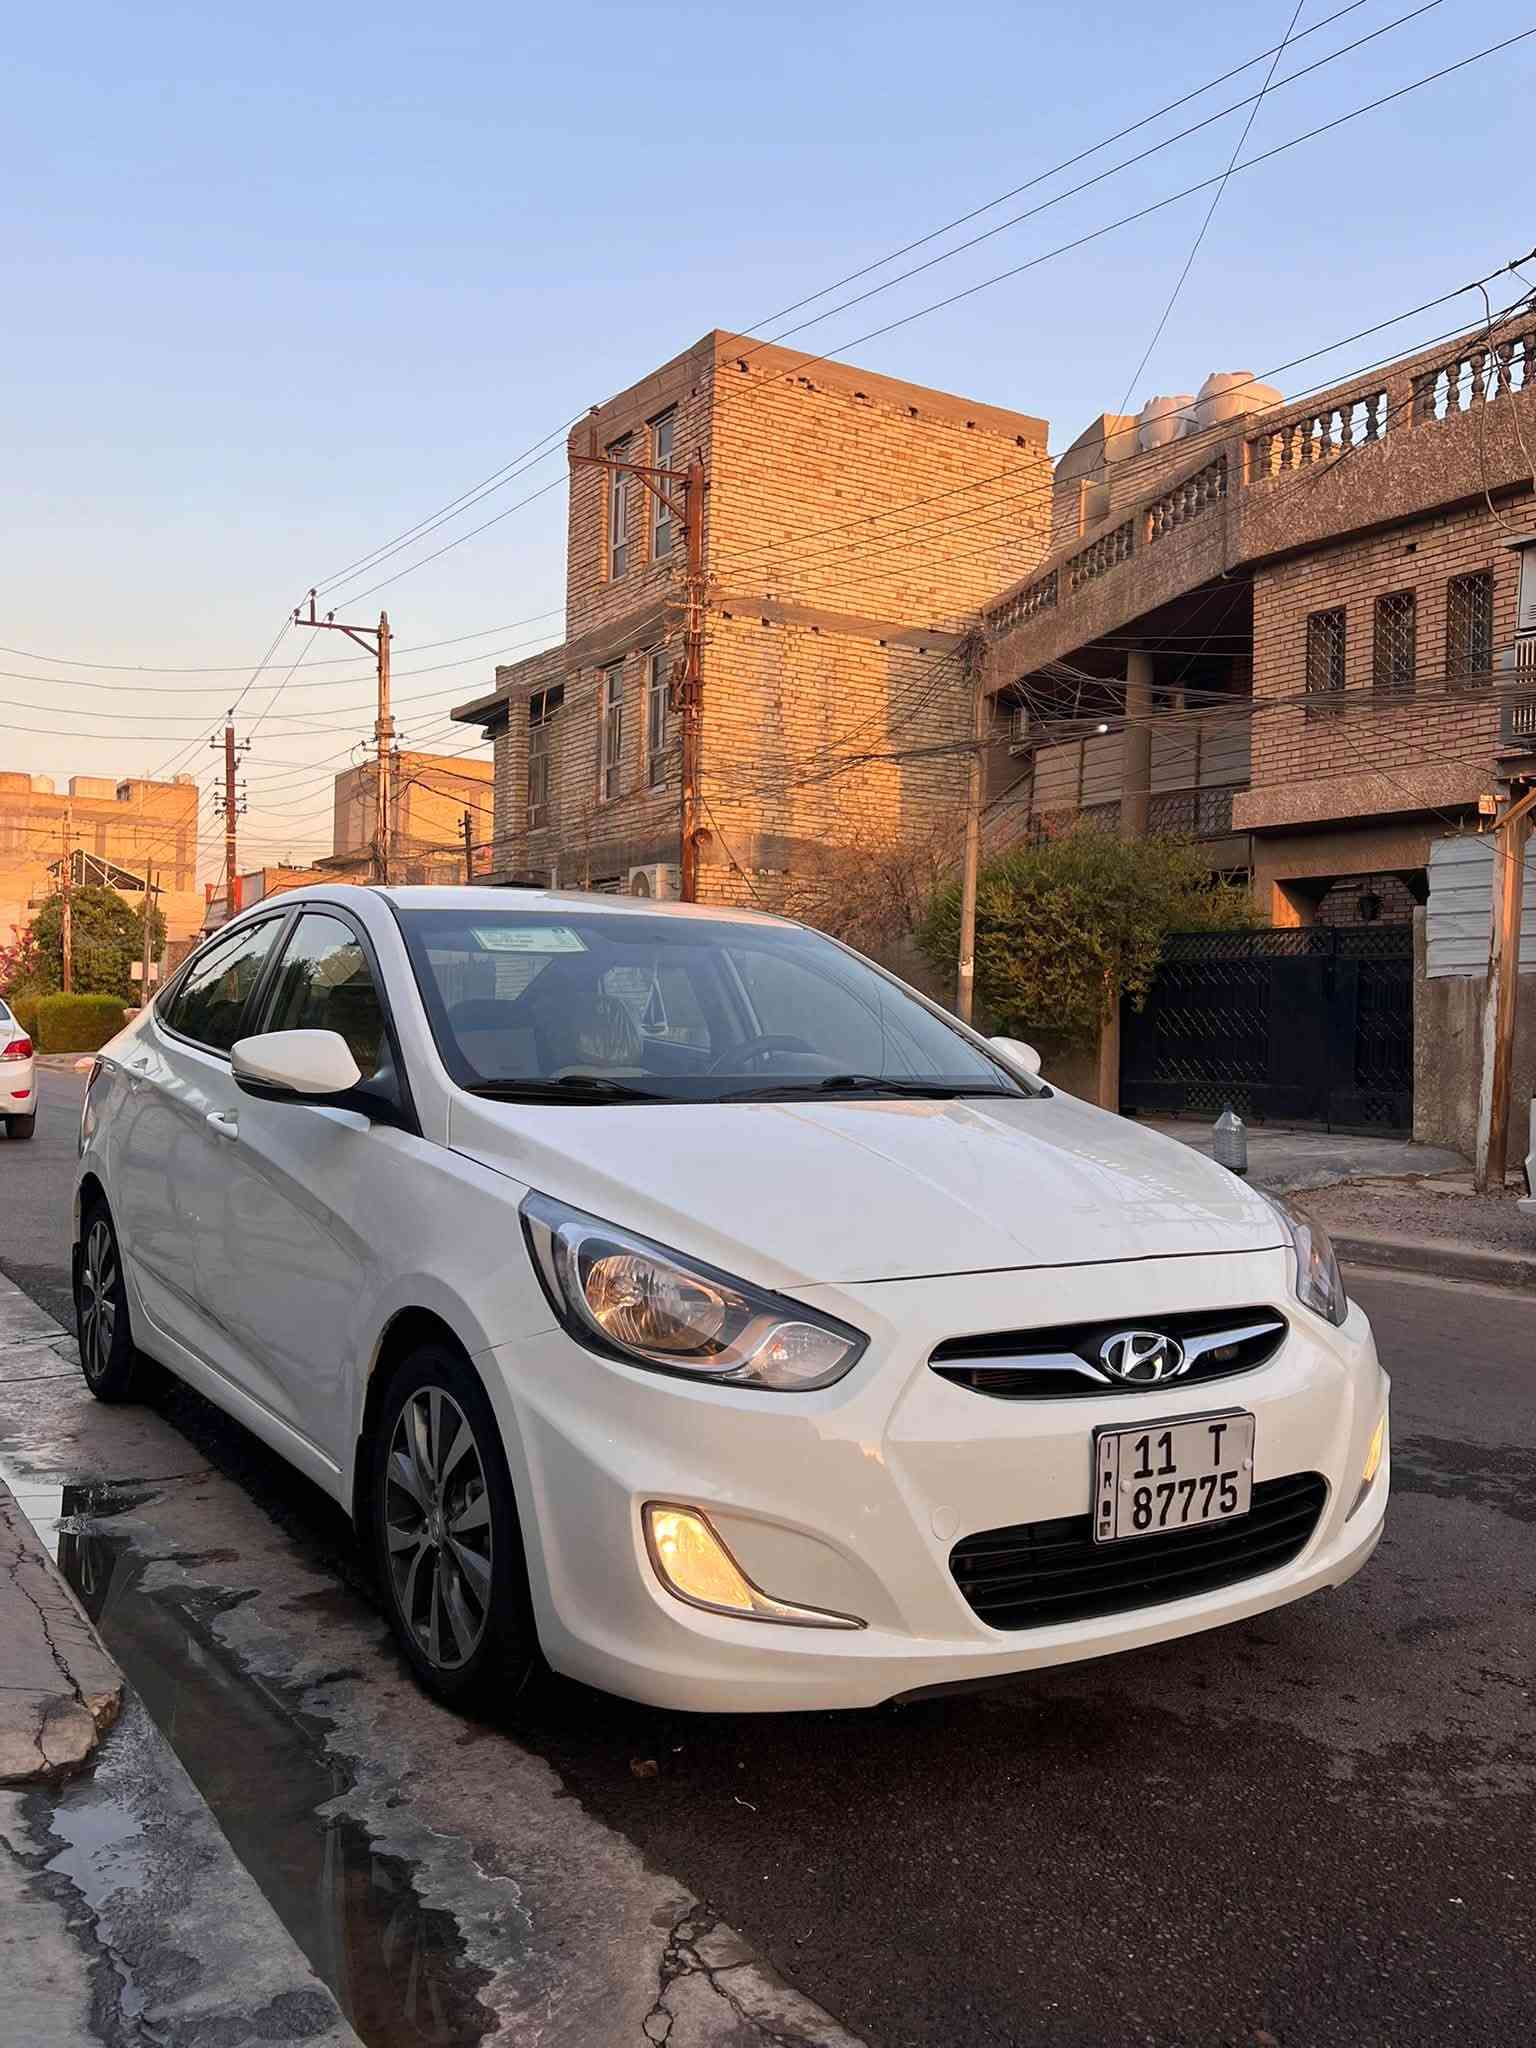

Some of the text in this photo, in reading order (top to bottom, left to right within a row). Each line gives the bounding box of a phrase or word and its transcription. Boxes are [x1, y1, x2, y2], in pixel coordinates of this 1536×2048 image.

[1133, 1423, 1227, 1479] 11 T
[1133, 1470, 1238, 1530] 87775
